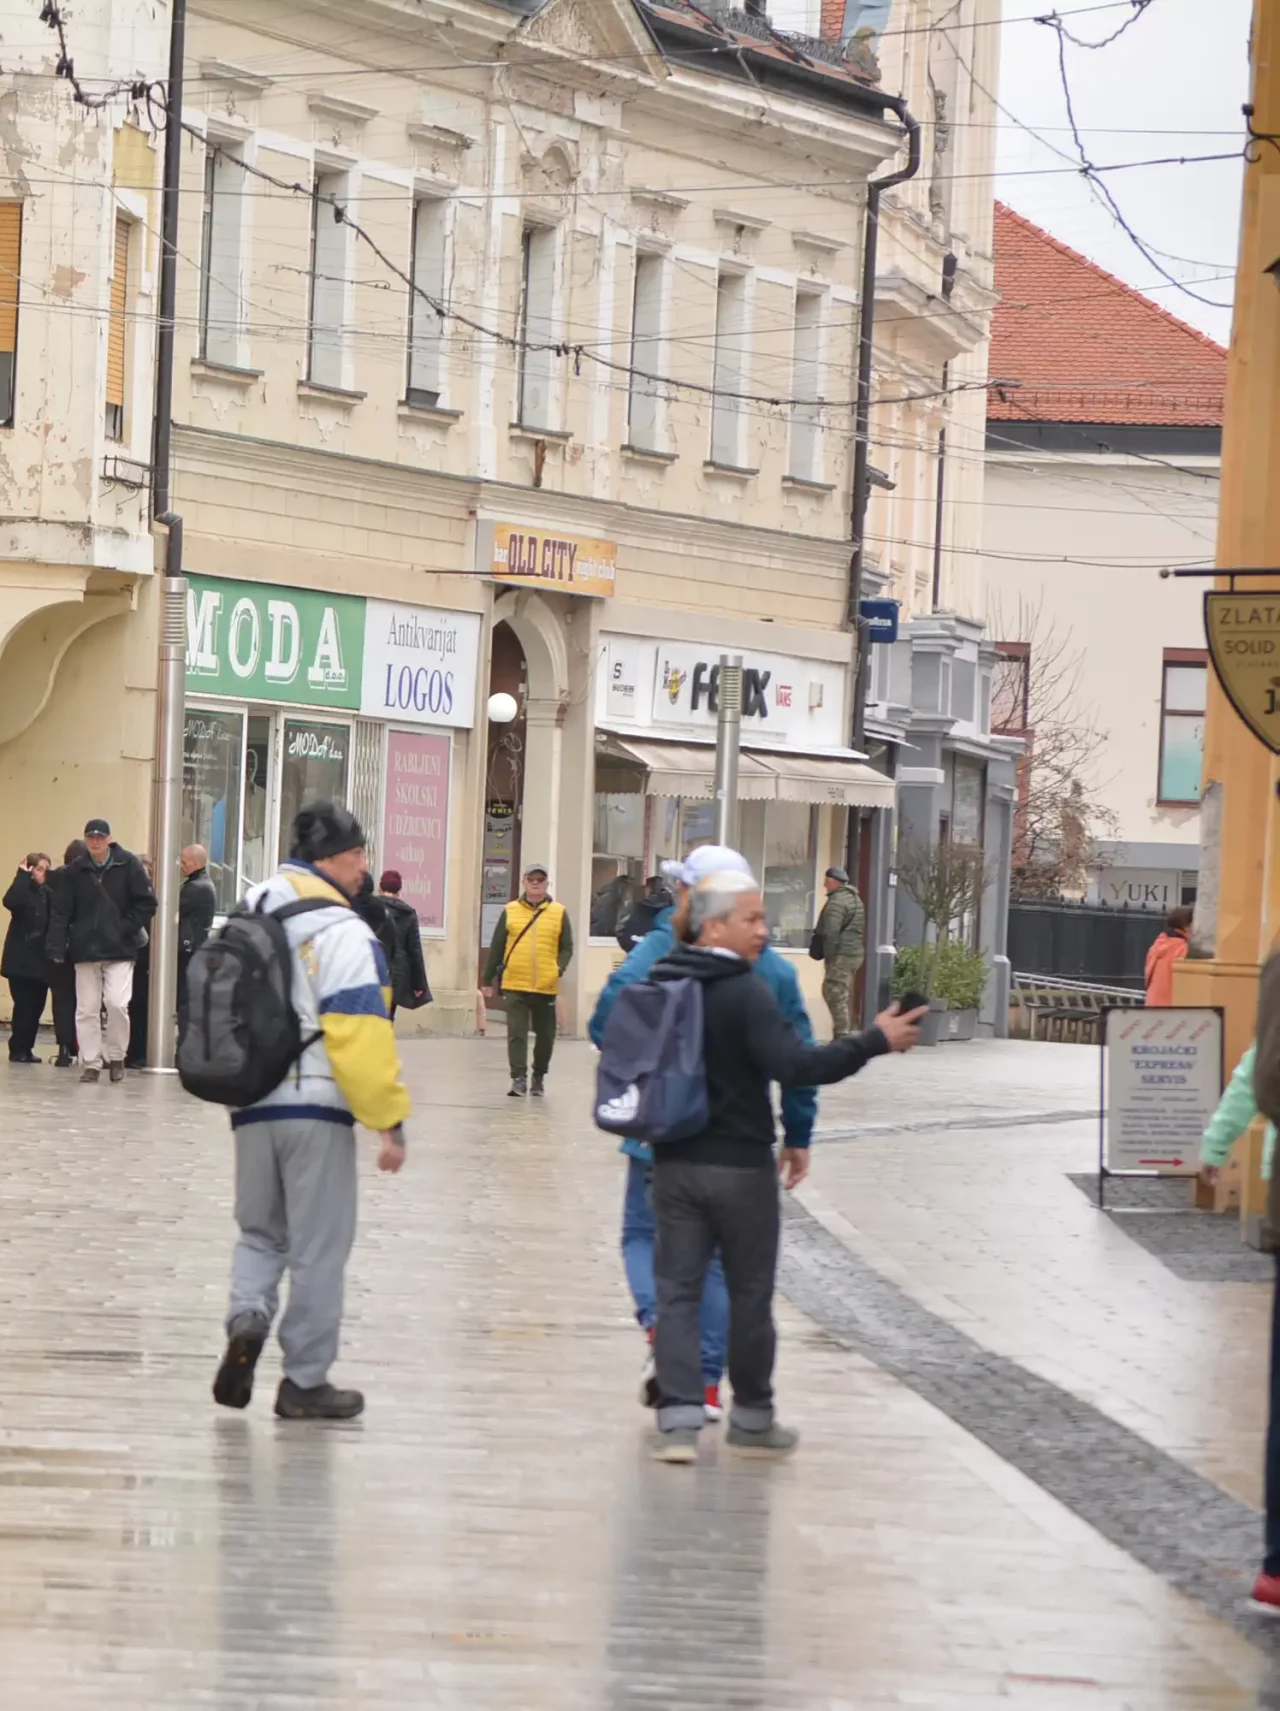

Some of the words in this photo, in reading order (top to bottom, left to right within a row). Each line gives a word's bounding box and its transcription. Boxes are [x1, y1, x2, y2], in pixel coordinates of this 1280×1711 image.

[508, 533, 538, 575] OLD
[541, 538, 578, 583] CITY
[185, 589, 348, 690] MODA
[387, 613, 458, 662] Antikvarijat
[1224, 639, 1275, 655] SOLID
[384, 664, 454, 715] LOGOS
[394, 751, 441, 776] RABLJENI
[395, 778, 437, 807] ŠKOLSKI
[389, 811, 442, 838] UDŽBENICI
[1110, 880, 1168, 902] YUKI
